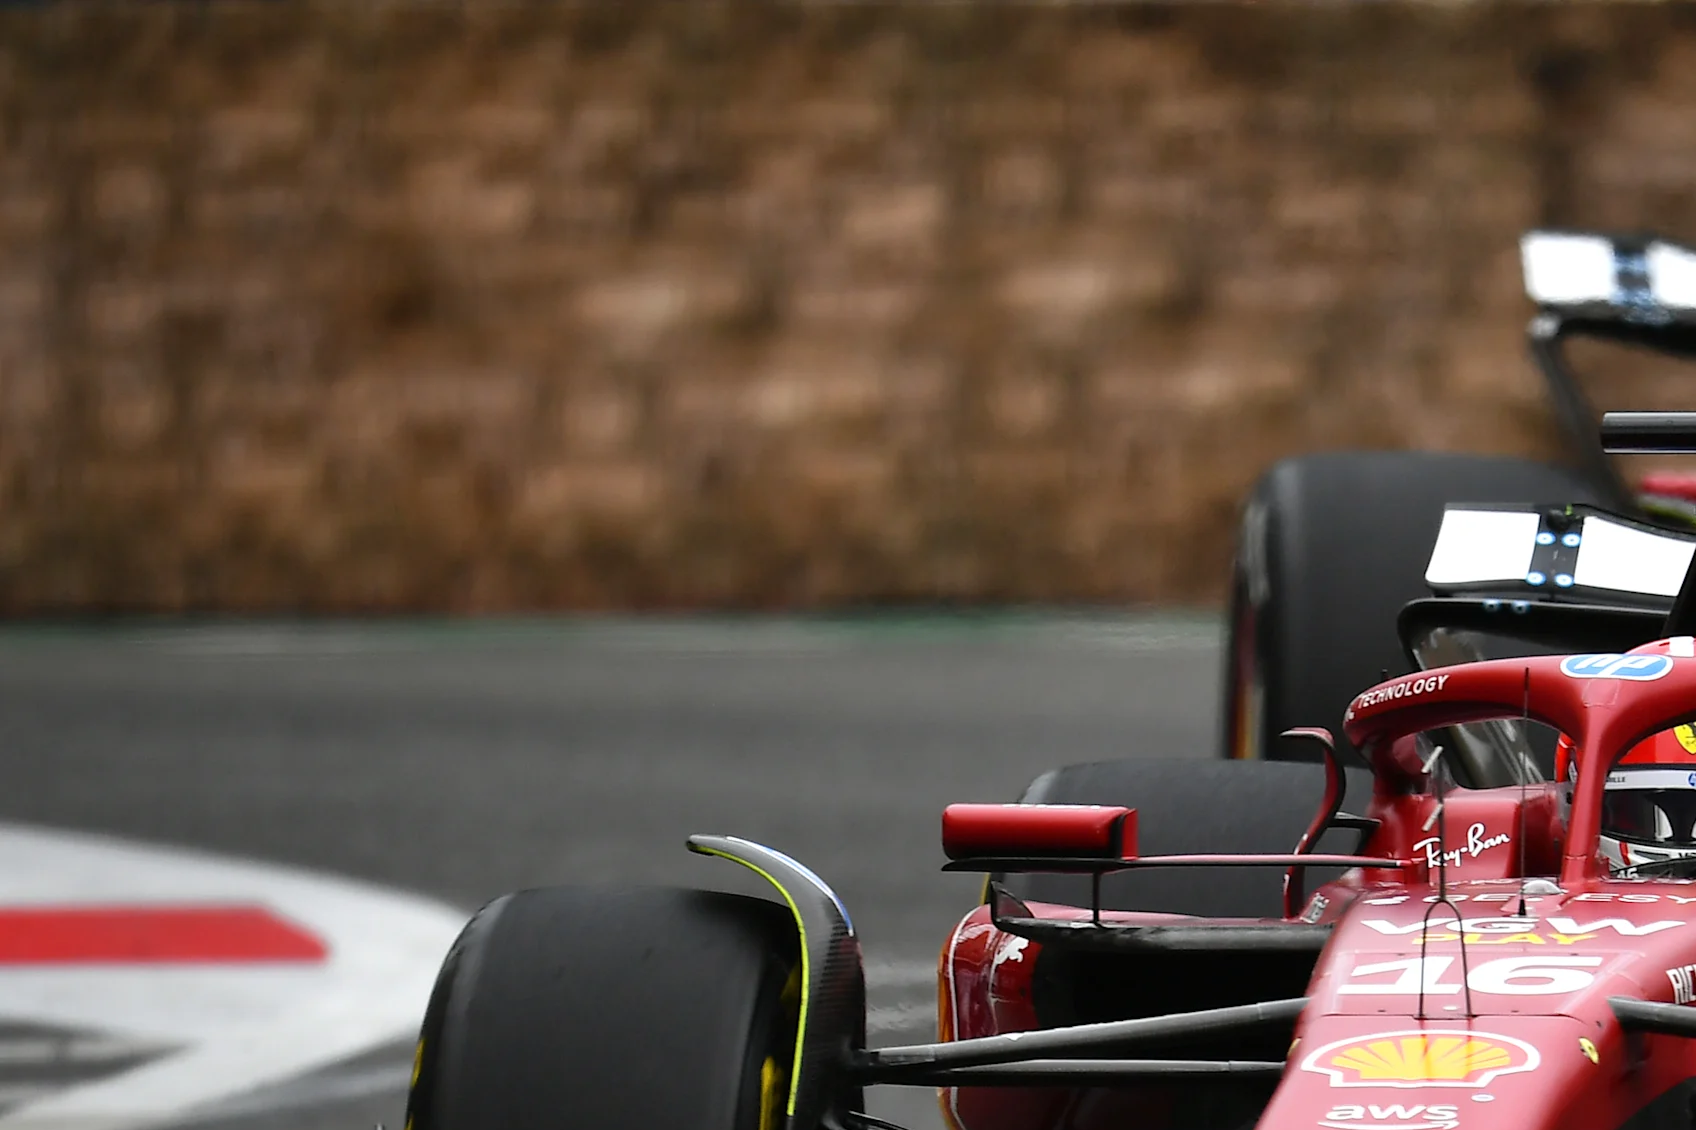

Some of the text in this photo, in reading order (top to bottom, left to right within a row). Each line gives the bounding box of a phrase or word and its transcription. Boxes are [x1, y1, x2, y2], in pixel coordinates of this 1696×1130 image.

[1358, 675, 1449, 708] TECHNOLOGY
[1413, 822, 1510, 867] Ray-Ban
[1361, 917, 1687, 936] VGW
[1412, 932, 1597, 945] PLAY
[1338, 955, 1603, 996] 16
[1325, 1104, 1459, 1121] aws
